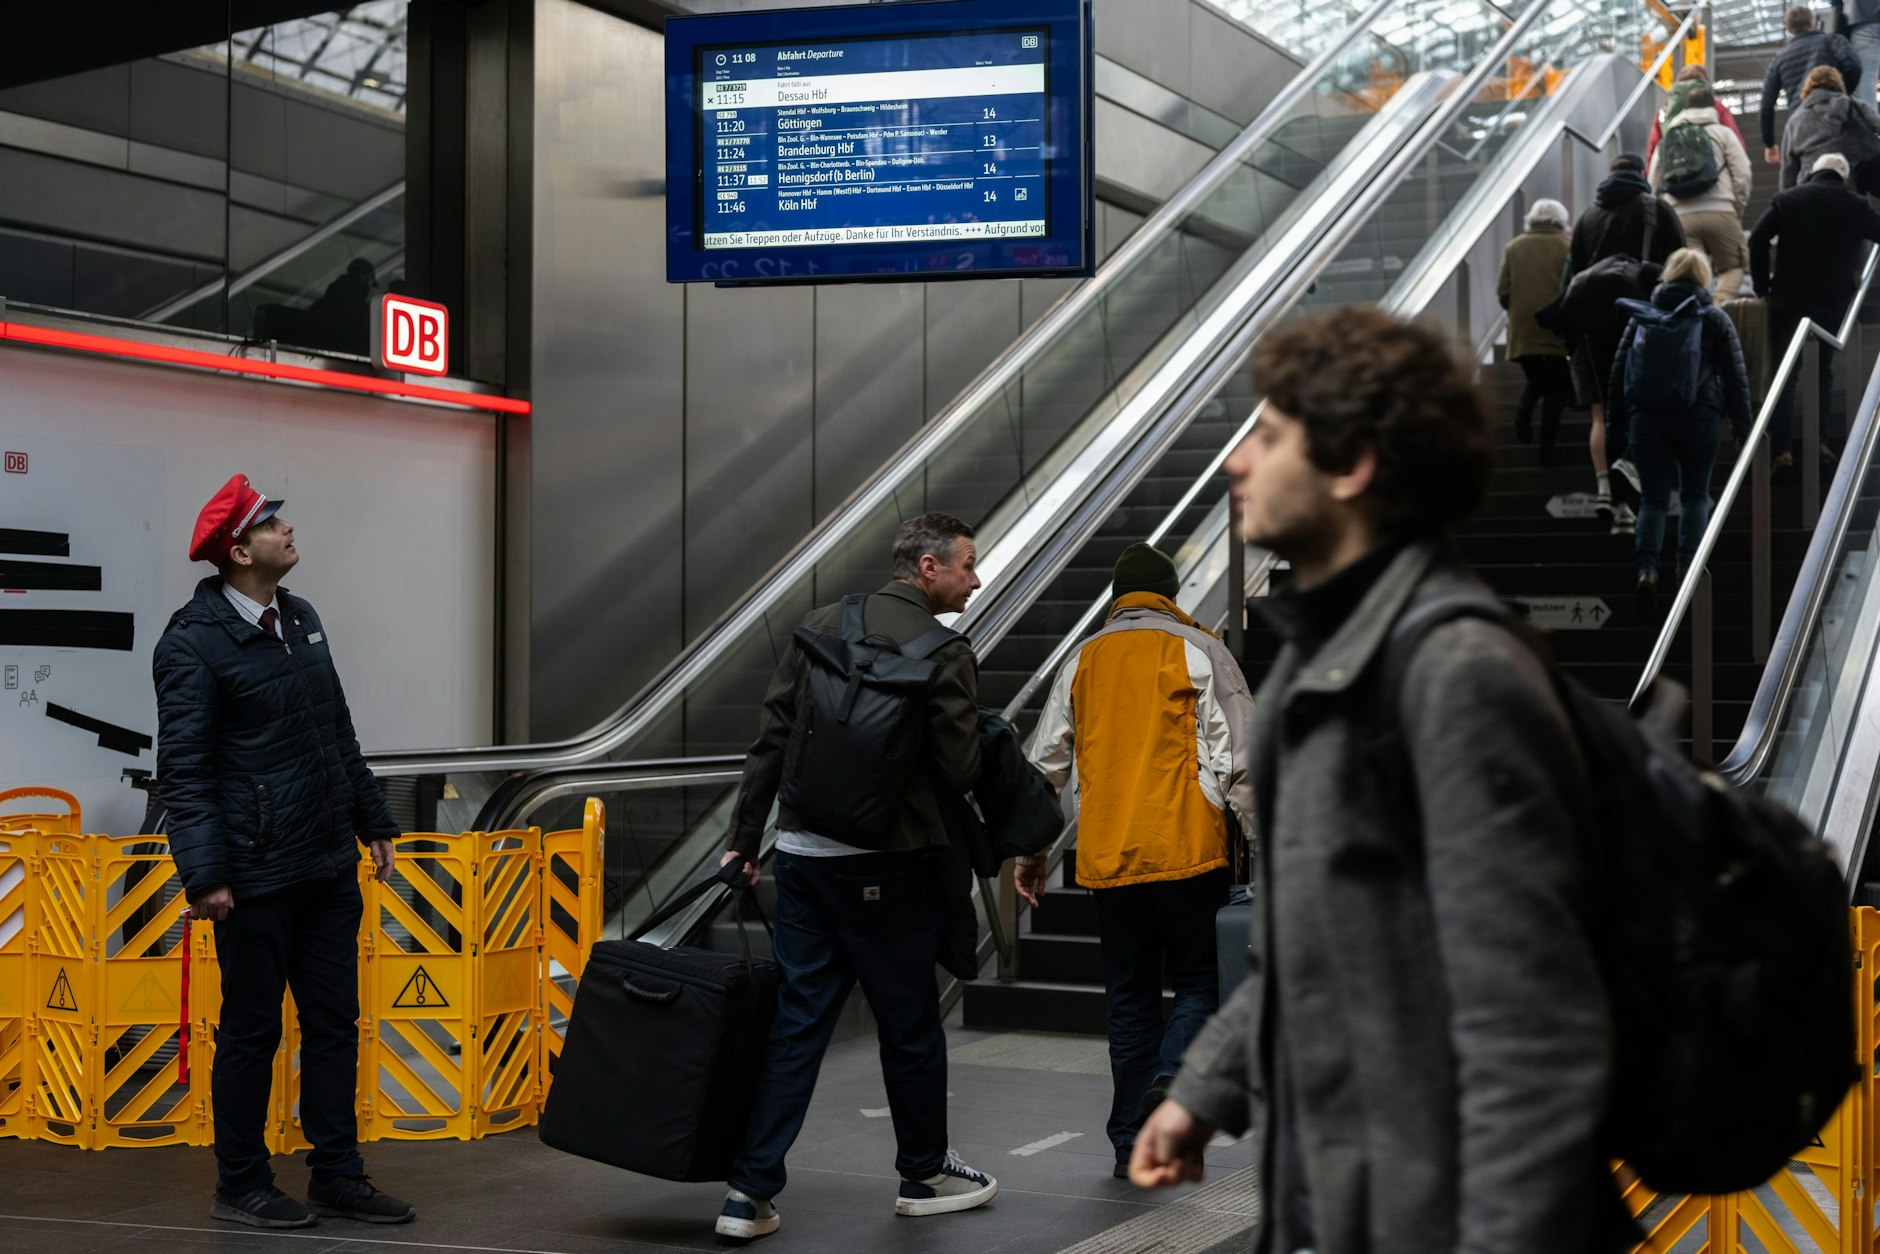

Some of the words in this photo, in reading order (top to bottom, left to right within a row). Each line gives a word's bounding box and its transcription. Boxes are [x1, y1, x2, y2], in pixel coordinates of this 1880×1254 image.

[745, 53, 756, 62] 08
[777, 51, 806, 60] Abfahrt
[807, 49, 844, 60] Departure
[717, 94, 744, 104] 11:15
[778, 91, 809, 101] Dessau
[812, 89, 828, 100] Hbf
[717, 121, 744, 132] 11:20
[778, 118, 822, 130] Göttingen
[983, 108, 996, 119] 14
[717, 148, 745, 160] 11:24
[778, 144, 835, 157] Brandenburg
[838, 142, 854, 154] Hbf
[984, 135, 996, 146] 13
[717, 175, 745, 186] 11:37
[845, 168, 875, 181] Berlin)
[984, 163, 996, 174] 14
[834, 186, 851, 195] (Westf)
[718, 201, 745, 213] 11:46
[778, 199, 798, 210] Köln
[801, 198, 817, 209] Hbf
[984, 191, 997, 202] 14
[730, 234, 742, 244] Sie
[745, 233, 780, 245] Treppen
[782, 232, 802, 242] oder
[804, 231, 843, 243] Aufzüge.
[846, 230, 873, 239] Danke
[877, 228, 888, 238] für
[892, 228, 903, 238] Ihr
[906, 226, 962, 238] Verständnis.
[985, 223, 1028, 236] Aufgrund
[392, 308, 440, 362] DB
[8, 455, 25, 470] DB
[1532, 604, 1566, 612] nutzen
